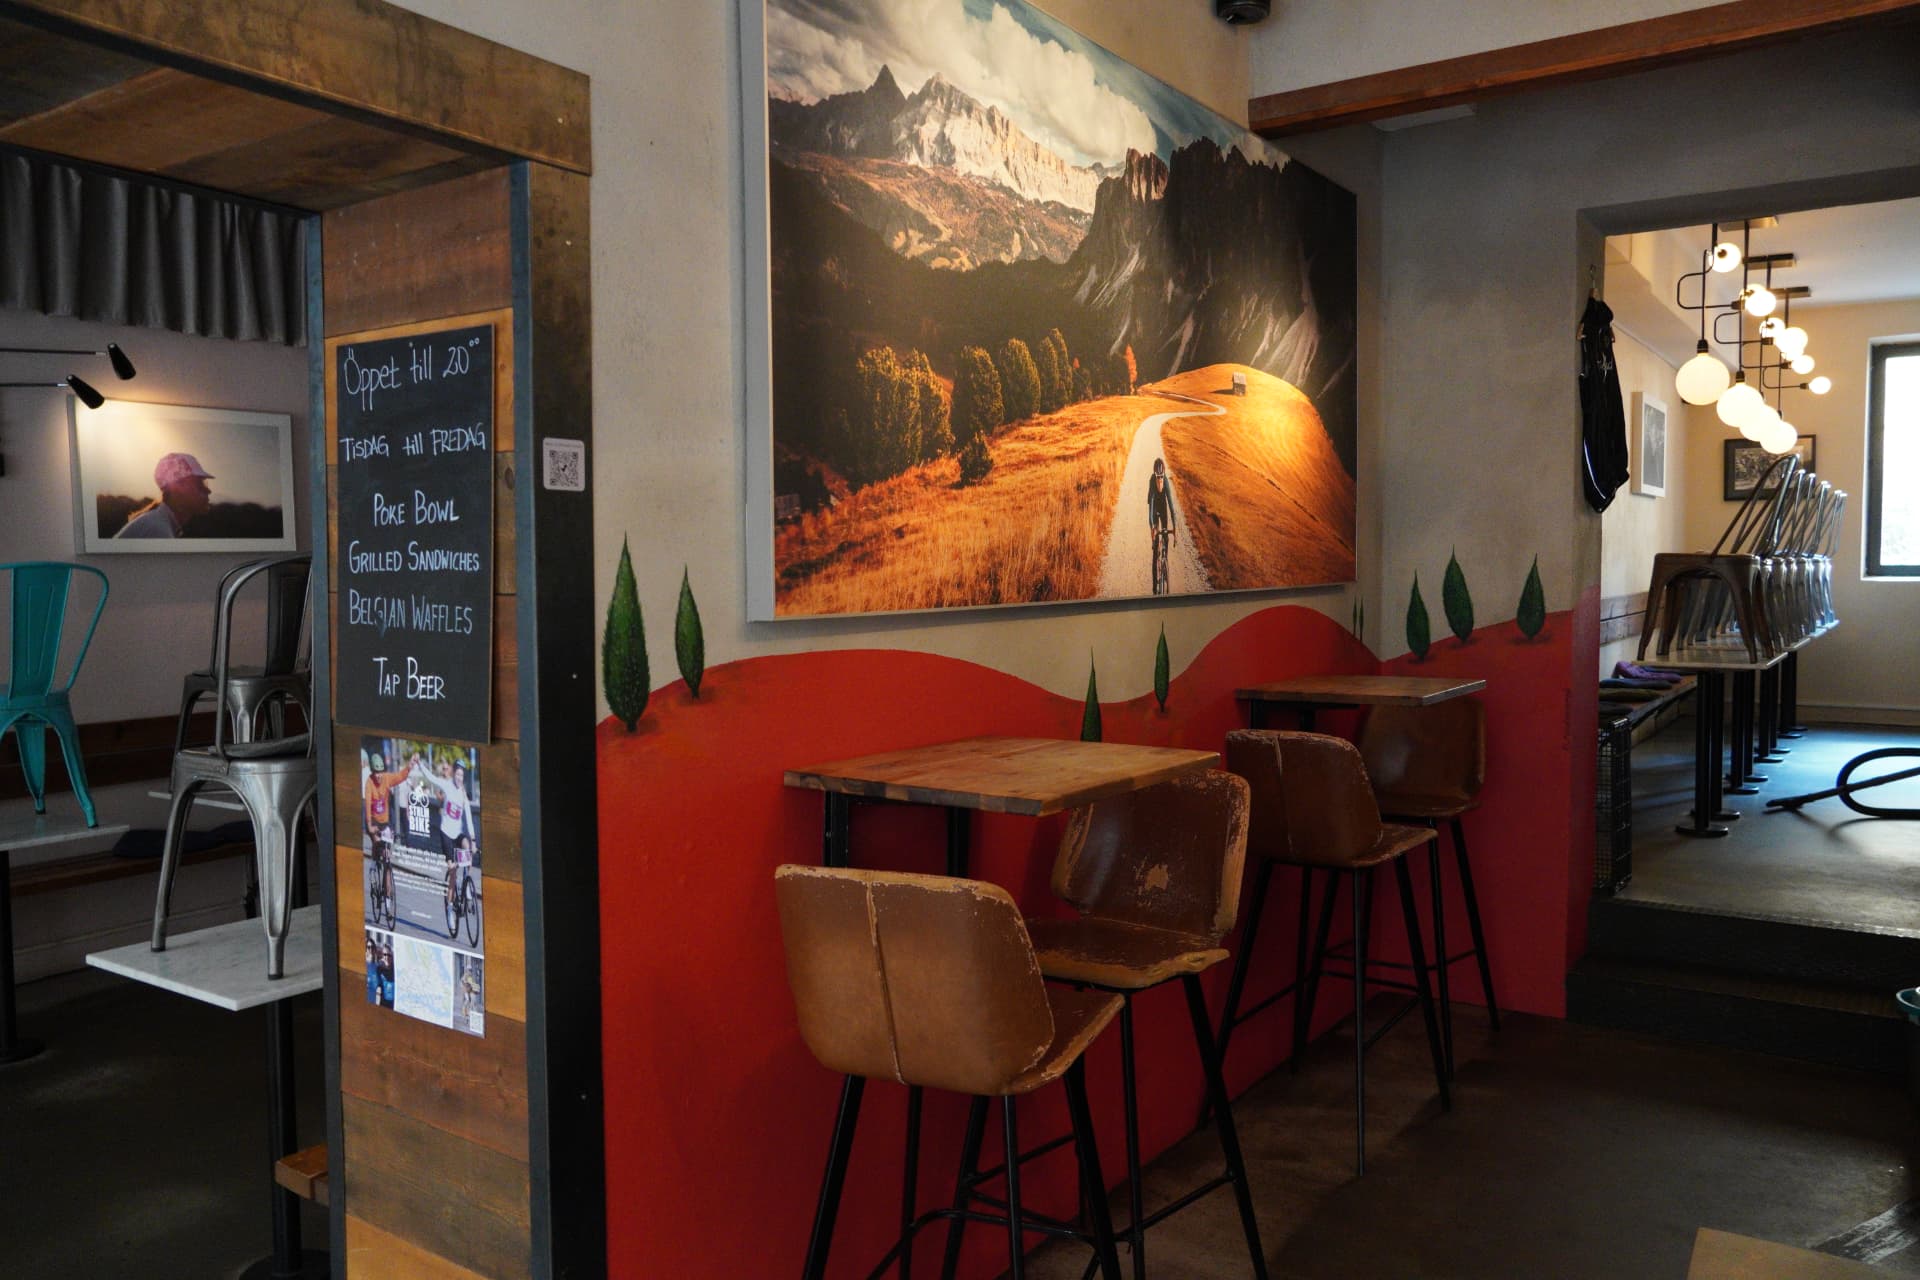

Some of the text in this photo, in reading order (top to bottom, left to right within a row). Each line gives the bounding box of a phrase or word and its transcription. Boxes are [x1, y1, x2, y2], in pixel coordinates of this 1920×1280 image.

[344, 346, 401, 411] Öppet
[410, 345, 432, 384] till
[402, 432, 424, 456] till
[430, 422, 486, 456] FREDAG
[374, 490, 459, 526] POKE BOWL
[349, 540, 480, 574] GRILLED SANDWICHES
[411, 594, 473, 635] WAFFLES
[372, 656, 446, 699] TAP BEER
[409, 816, 431, 833] BIKE
